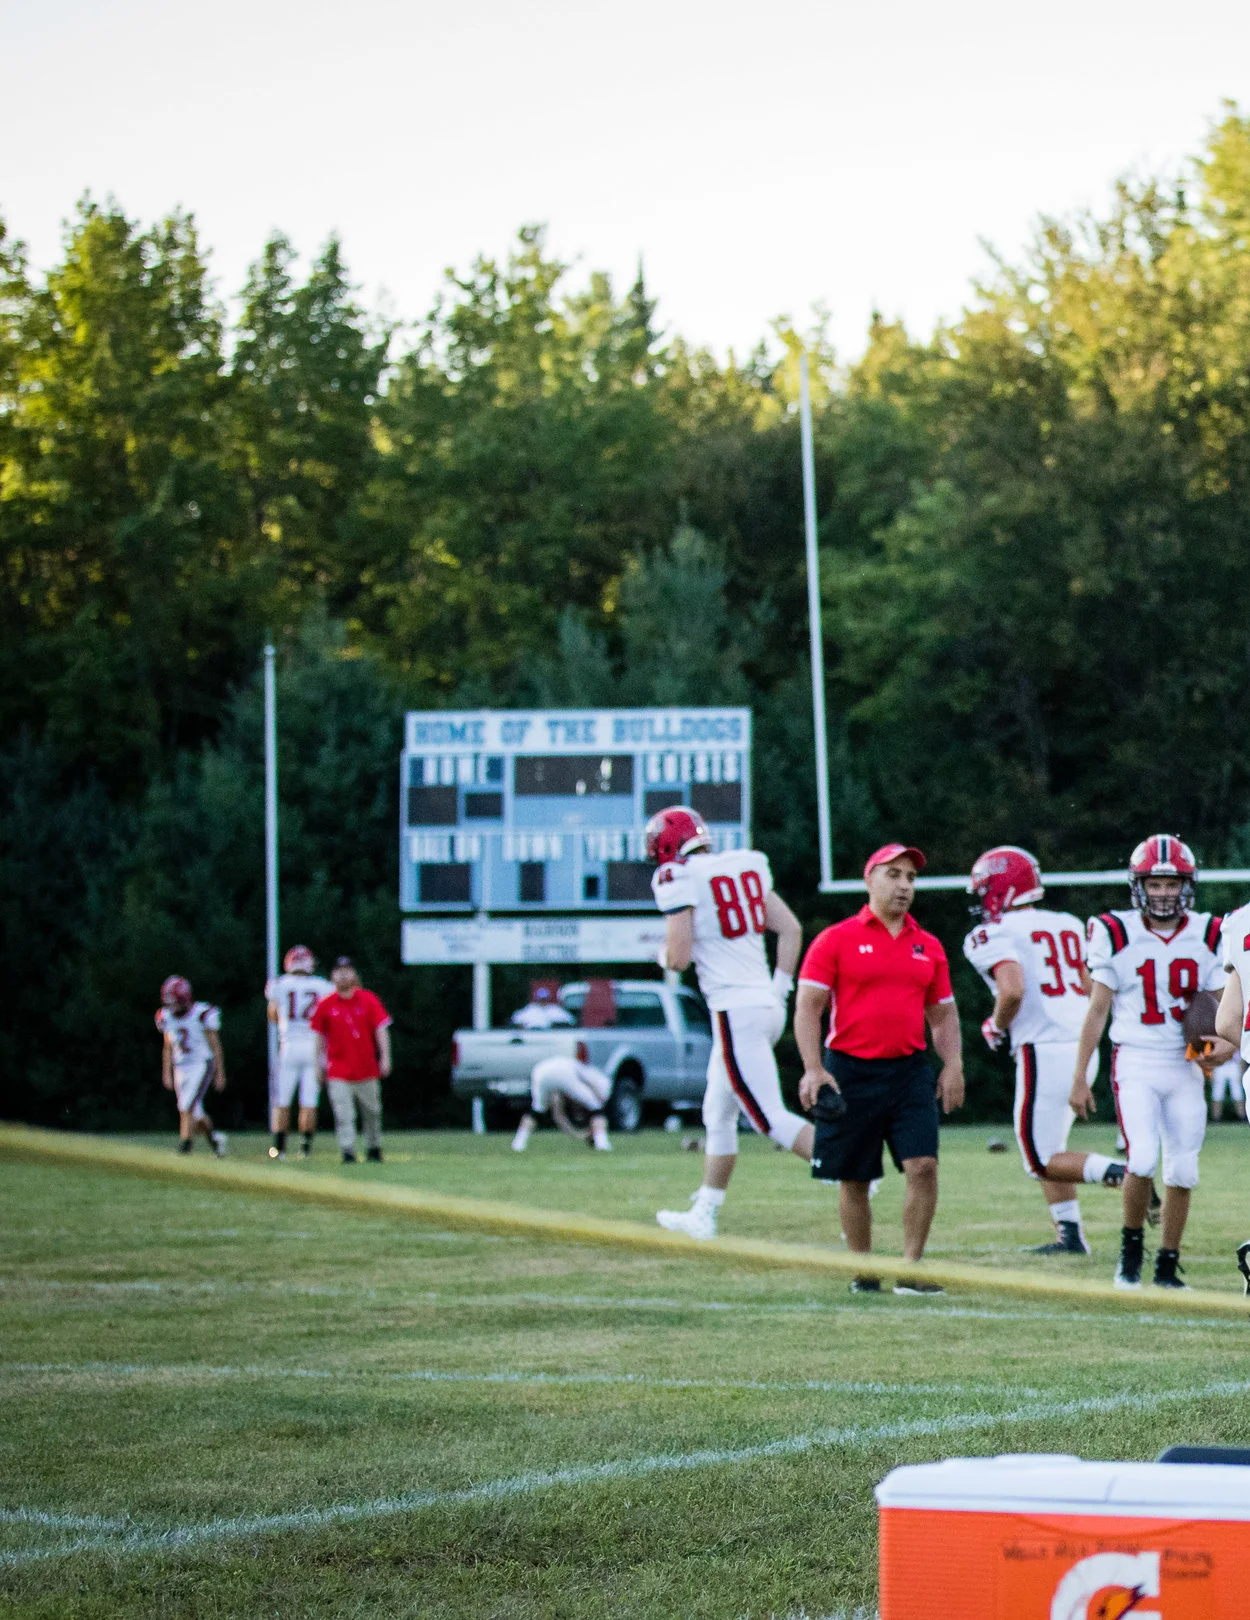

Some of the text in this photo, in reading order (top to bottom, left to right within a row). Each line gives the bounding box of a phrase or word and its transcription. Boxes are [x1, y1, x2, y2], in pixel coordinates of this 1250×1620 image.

[414, 717, 742, 746] HOME OF THE BULLDOGS
[709, 870, 767, 939] 88
[1031, 930, 1088, 997] 39
[1135, 958, 1199, 1025] 19
